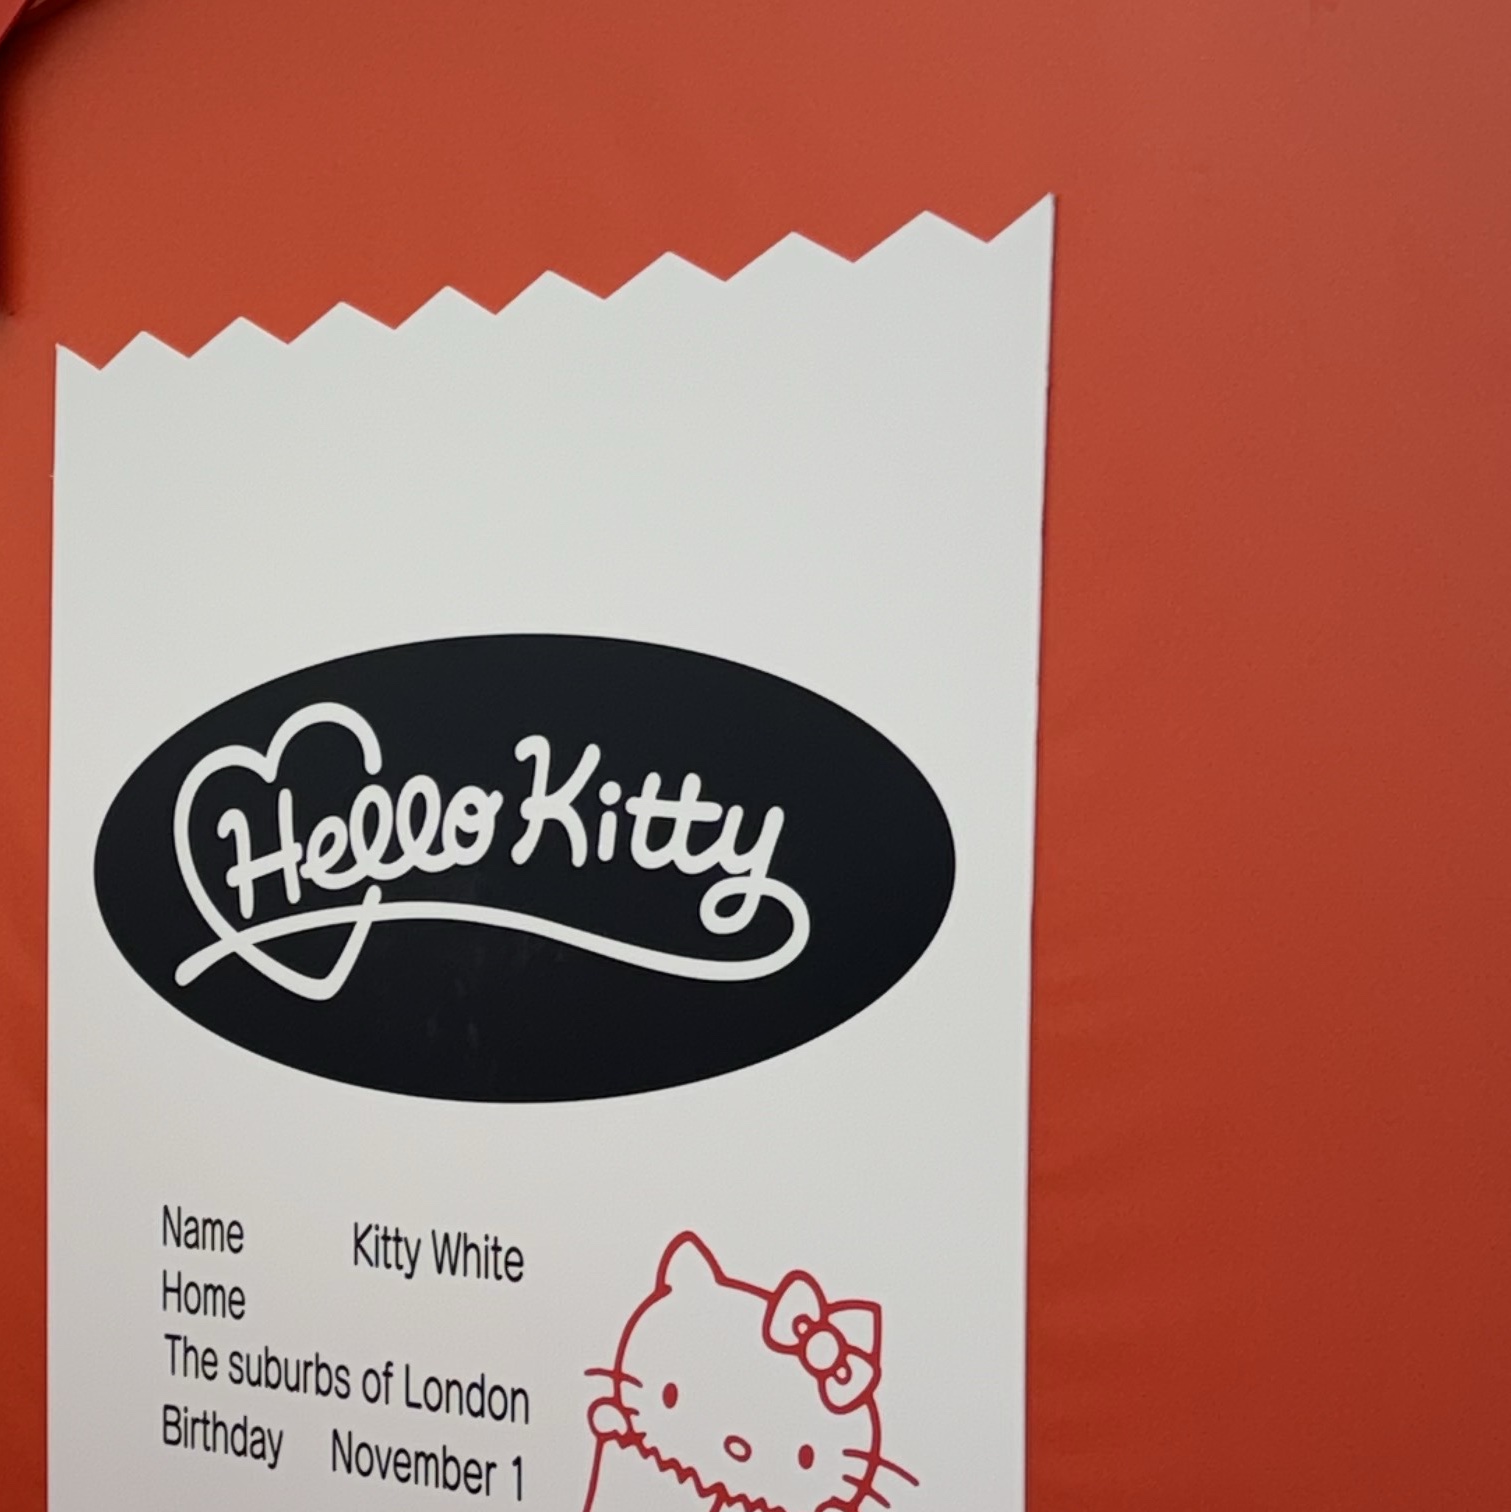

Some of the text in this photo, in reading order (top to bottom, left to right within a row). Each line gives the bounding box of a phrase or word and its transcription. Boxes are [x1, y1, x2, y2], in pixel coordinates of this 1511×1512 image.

[218, 734, 810, 936] Hello Kitty
[162, 1204, 525, 1283] Name Kitty White
[162, 1269, 246, 1320] Home
[164, 1333, 530, 1425] The suburbs of London
[162, 1403, 523, 1502] Birthday November 1
